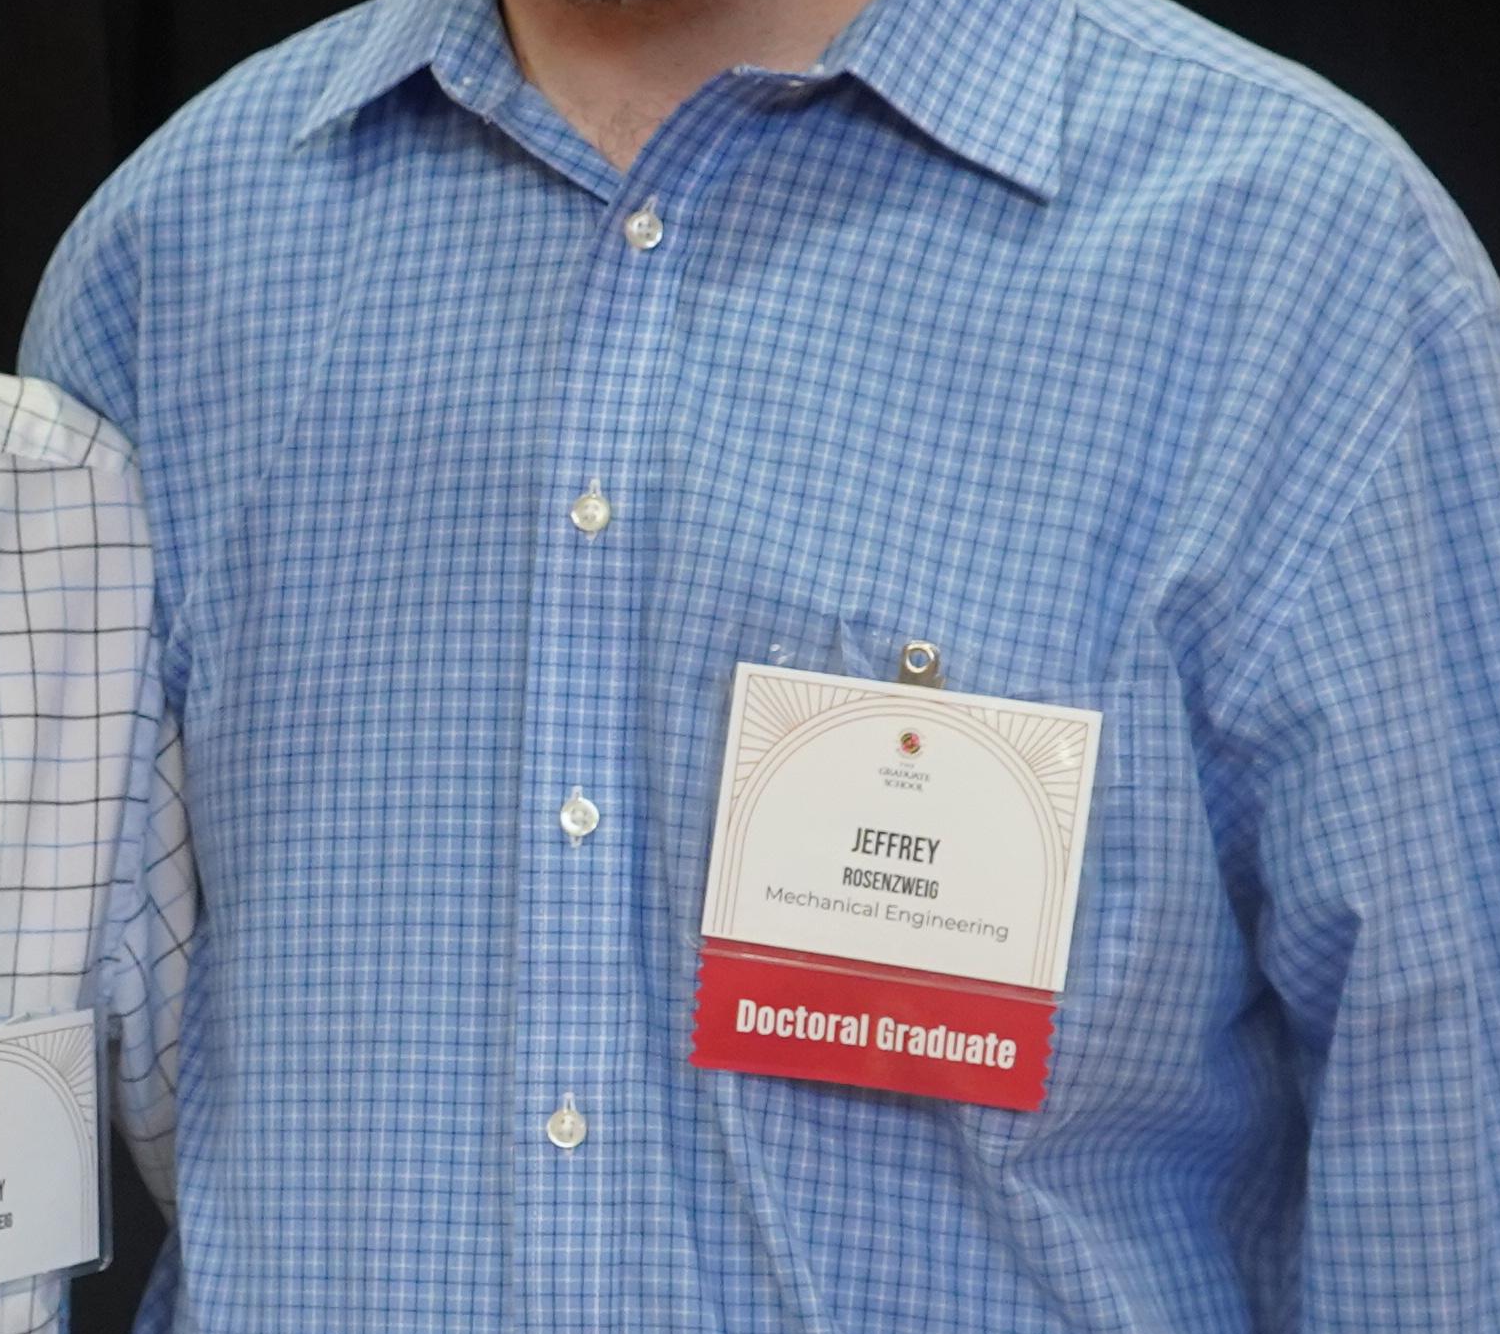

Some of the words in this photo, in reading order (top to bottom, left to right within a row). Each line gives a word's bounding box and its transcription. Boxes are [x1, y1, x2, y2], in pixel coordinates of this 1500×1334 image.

[878, 767, 931, 783] GRADUATE
[884, 778, 923, 793] SCHOOL
[851, 826, 941, 865] JEFFREY
[842, 866, 940, 900] ROSENZWEIG
[765, 884, 880, 919] Mechanical
[885, 904, 1010, 944] Engineering
[735, 998, 868, 1048] Doctoral
[876, 1016, 1017, 1070] Graduate
